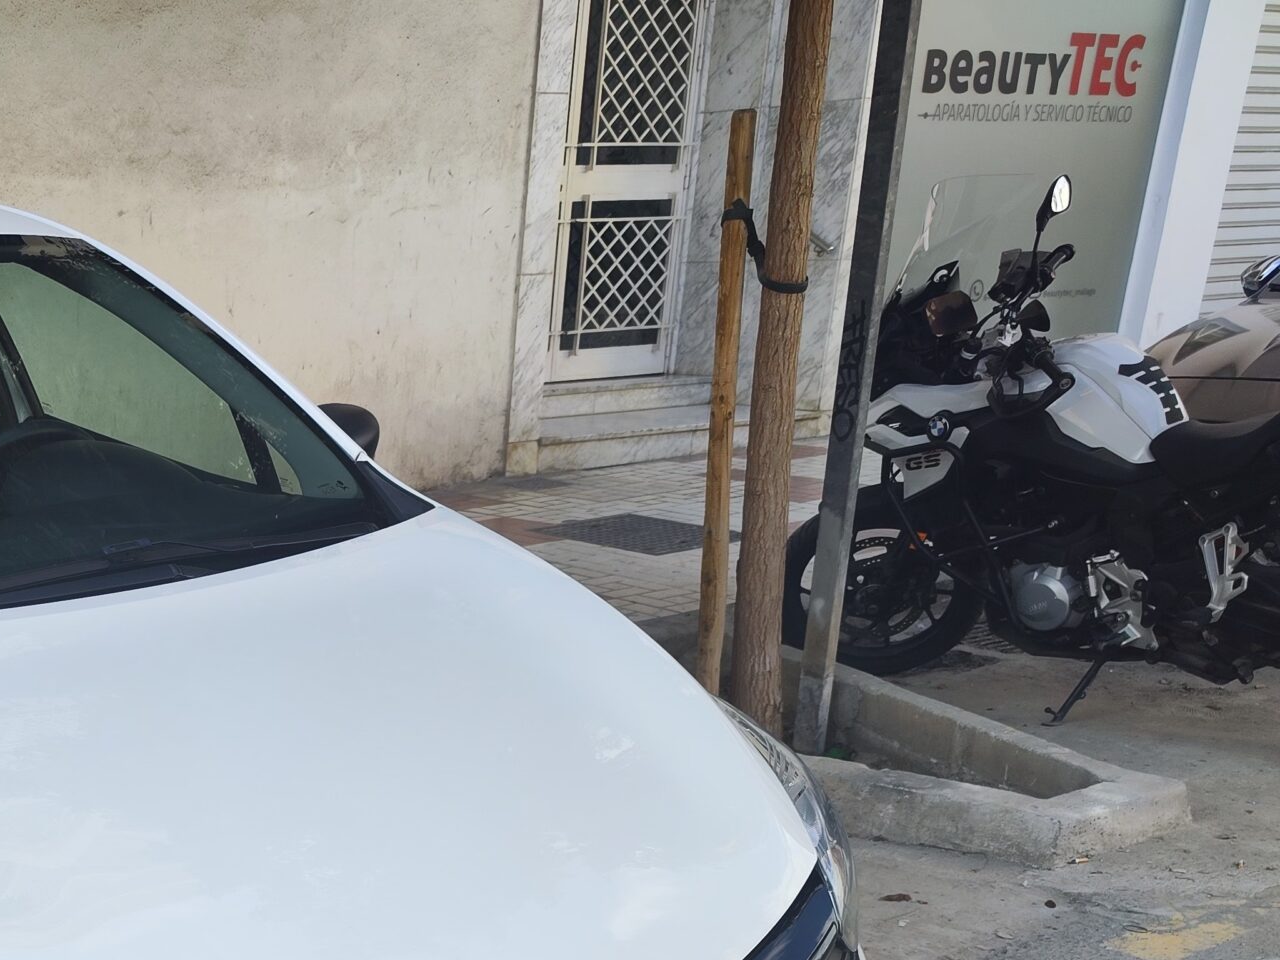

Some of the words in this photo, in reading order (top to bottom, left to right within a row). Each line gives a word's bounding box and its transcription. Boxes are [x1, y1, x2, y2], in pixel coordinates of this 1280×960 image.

[933, 100, 1021, 122] APARATOLOGÍA
[1024, 104, 1034, 121] Y
[1033, 104, 1084, 122] SERVICIO
[1087, 101, 1133, 123] TÉCNICO
[905, 452, 942, 471] GS
